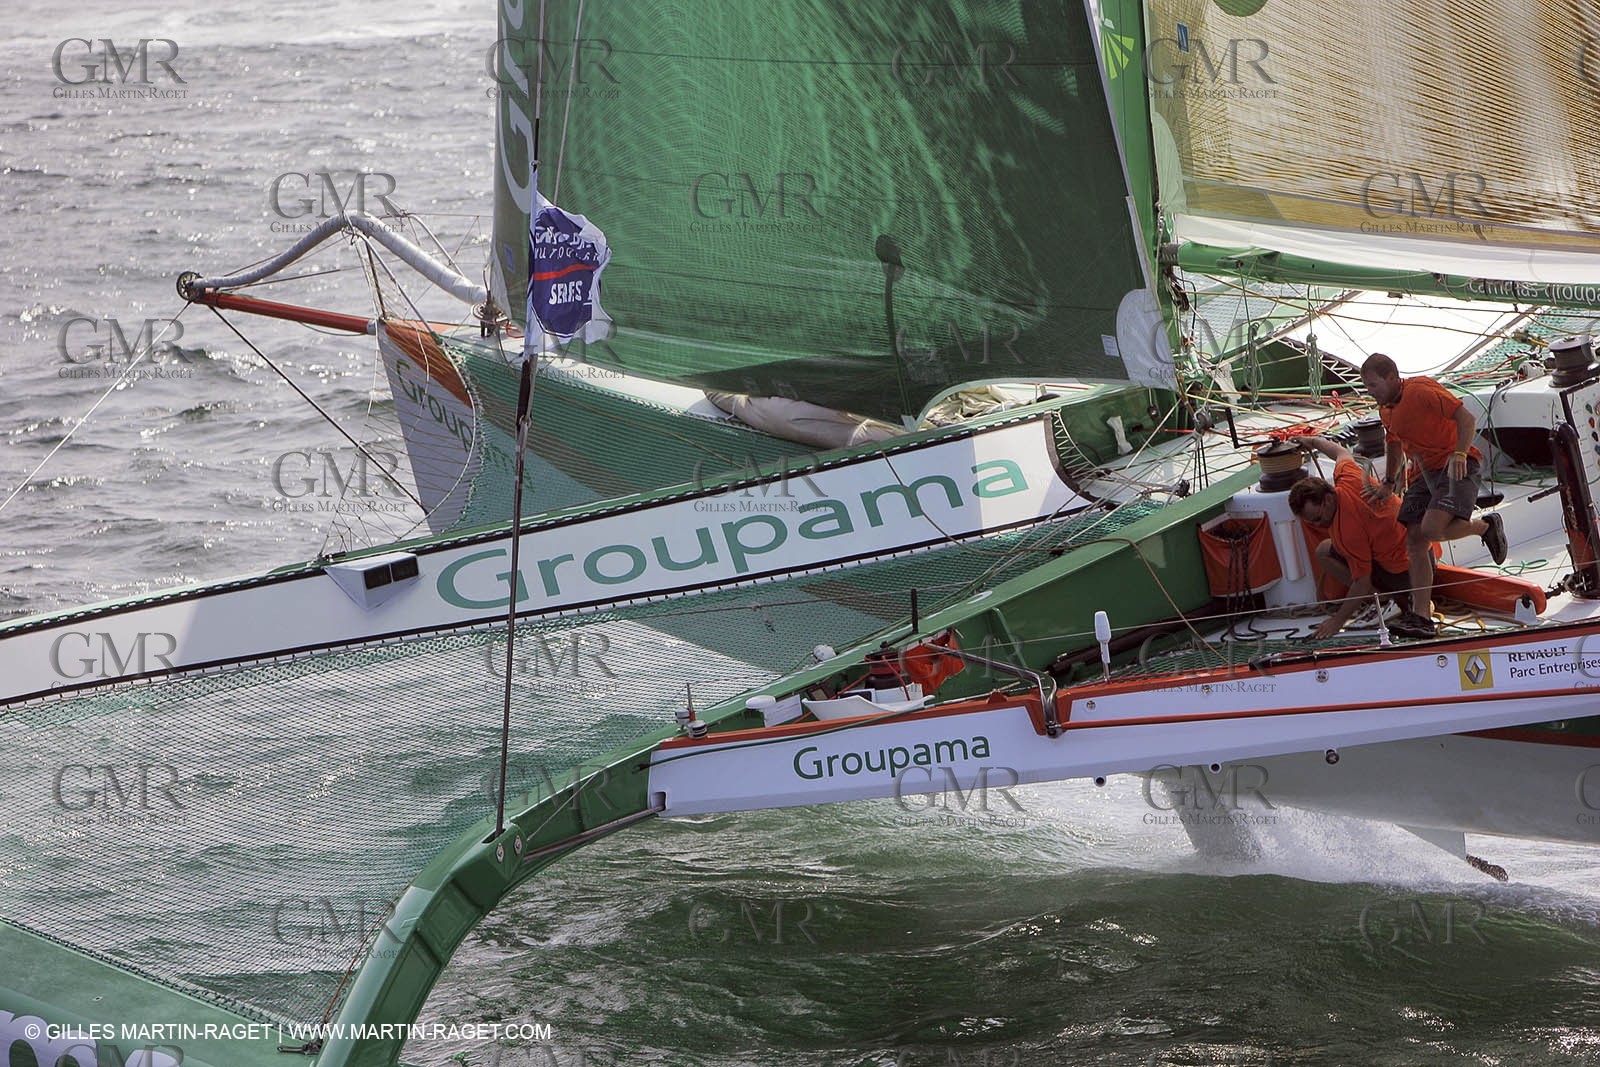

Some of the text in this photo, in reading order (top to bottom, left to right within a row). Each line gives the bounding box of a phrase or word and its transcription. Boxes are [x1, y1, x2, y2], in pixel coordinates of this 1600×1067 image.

[436, 458, 1030, 610] Groupama
[1508, 645, 1568, 663] RENAULT
[1510, 657, 1600, 679] Parc Entreprises
[793, 735, 991, 780] Groupama
